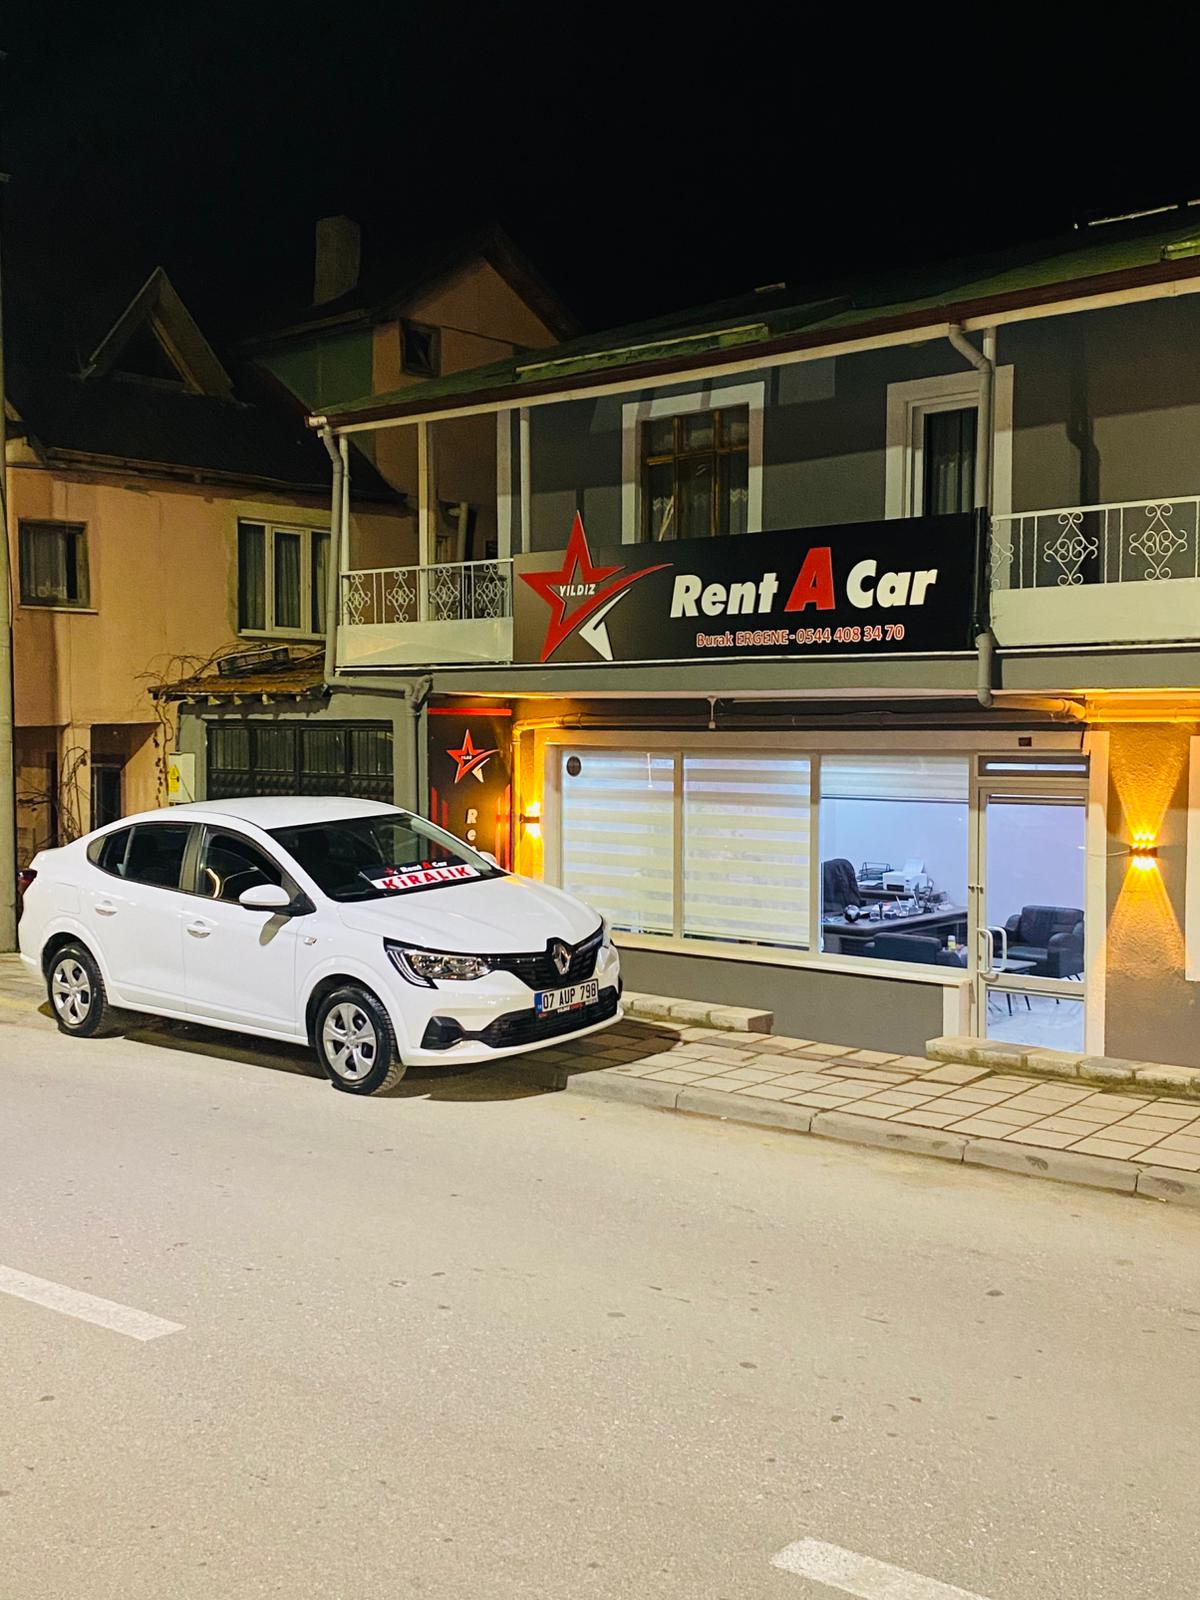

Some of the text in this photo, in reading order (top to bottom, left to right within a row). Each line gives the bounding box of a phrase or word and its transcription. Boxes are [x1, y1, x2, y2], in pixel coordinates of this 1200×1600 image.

[559, 583, 596, 597] YILDIZ
[670, 546, 938, 618] Rent A Car
[696, 632, 734, 648] Burak
[833, 627, 861, 643] 408
[863, 625, 883, 642] 34
[885, 624, 905, 640] 70
[543, 993, 555, 1010] 07
[559, 988, 576, 1006] AUP
[580, 983, 597, 1001] 798
